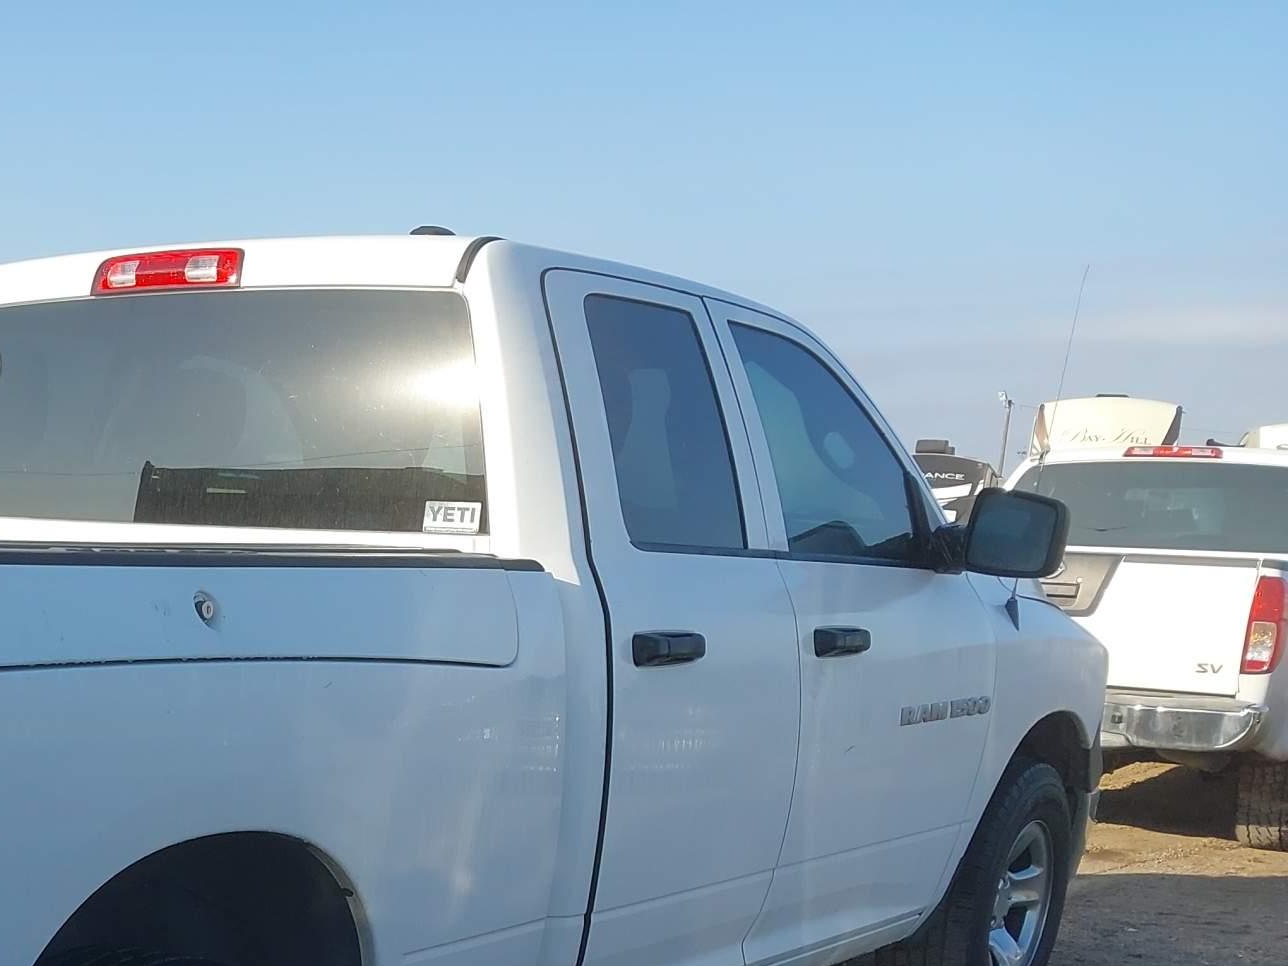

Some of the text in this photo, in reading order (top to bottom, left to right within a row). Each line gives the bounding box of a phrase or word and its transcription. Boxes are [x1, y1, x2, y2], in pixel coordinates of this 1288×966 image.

[922, 472, 965, 481] ANCE
[429, 506, 476, 523] YETI
[1195, 663, 1223, 674] SV
[900, 701, 949, 726] RAM
